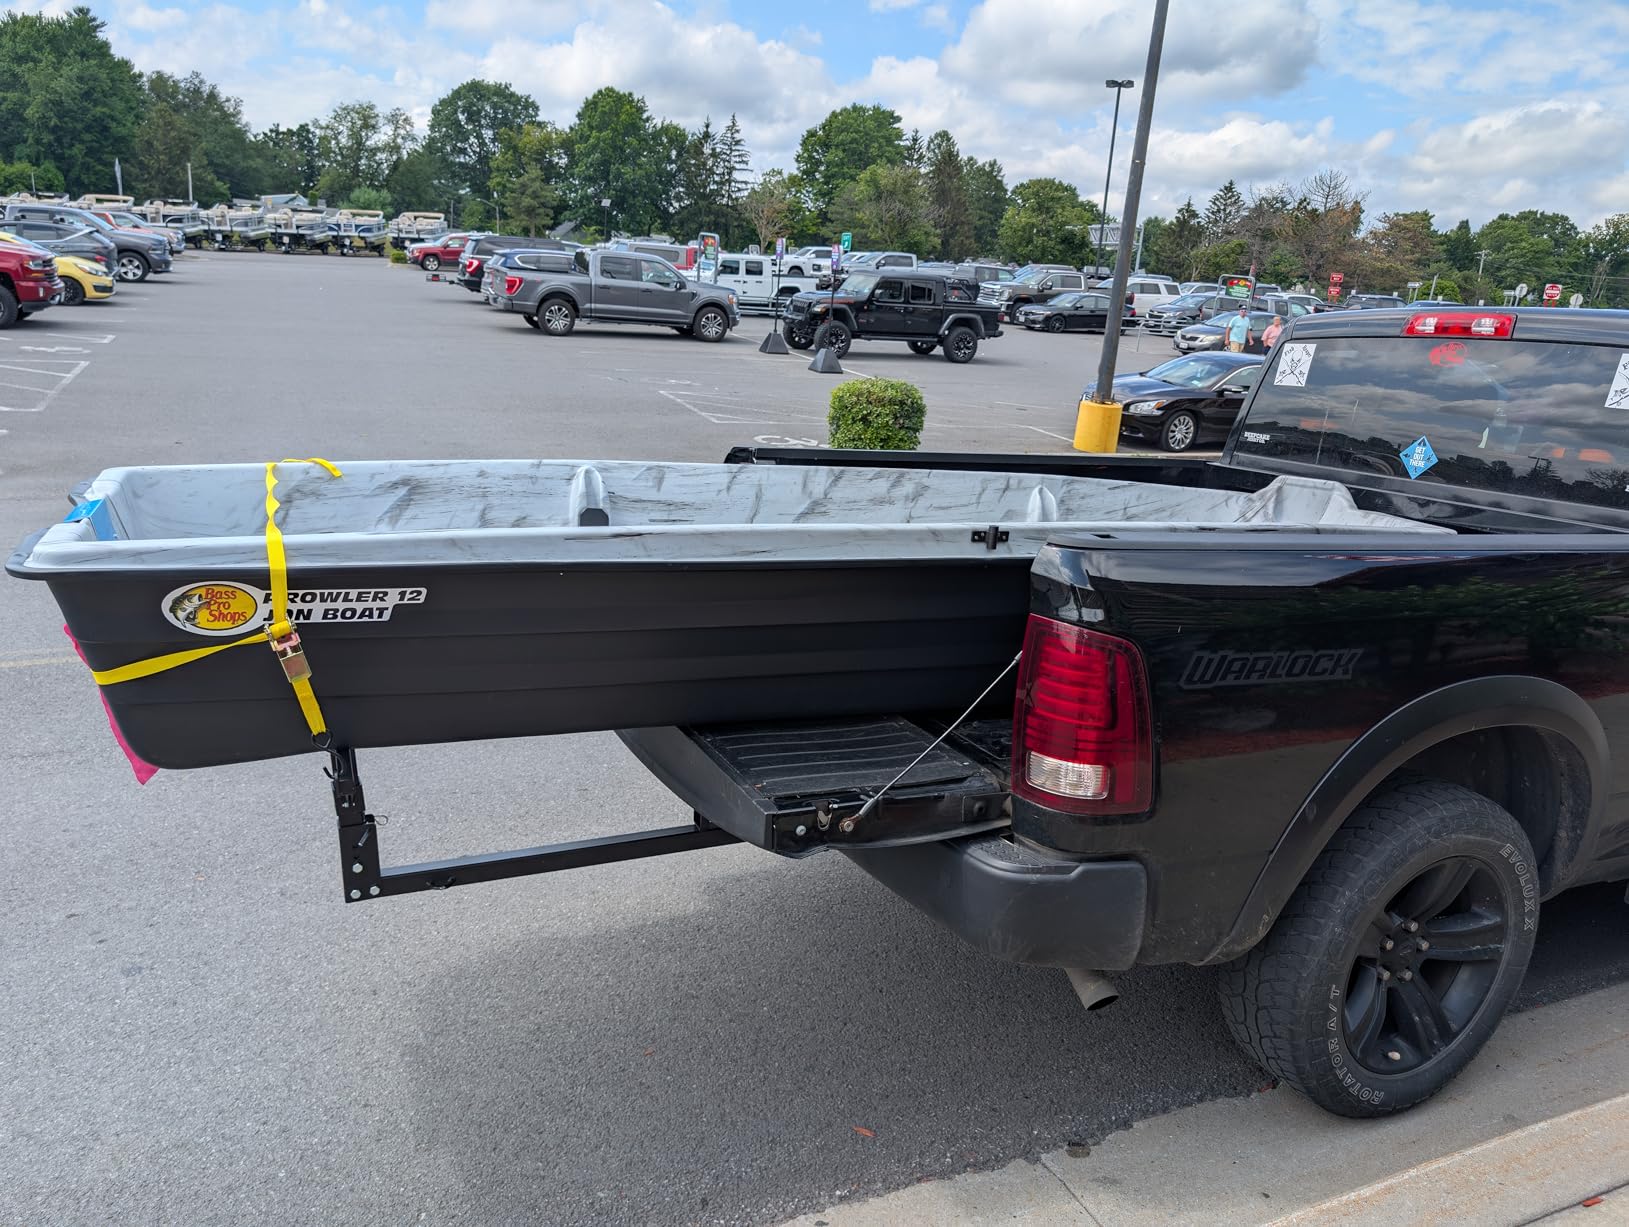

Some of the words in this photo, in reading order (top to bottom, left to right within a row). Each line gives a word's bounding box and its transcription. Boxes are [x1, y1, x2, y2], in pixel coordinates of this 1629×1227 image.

[1415, 446, 1426, 454] GET
[1409, 459, 1424, 467] THERE
[204, 588, 237, 600] Bass
[397, 590, 423, 602] 12
[206, 600, 231, 611] Pro
[207, 609, 247, 625] Shops
[321, 607, 389, 621] BOAT
[1178, 649, 1364, 689] WARLOCK
[1327, 984, 1340, 1030] A/T
[1328, 1038, 1384, 1104] ROTATOR
